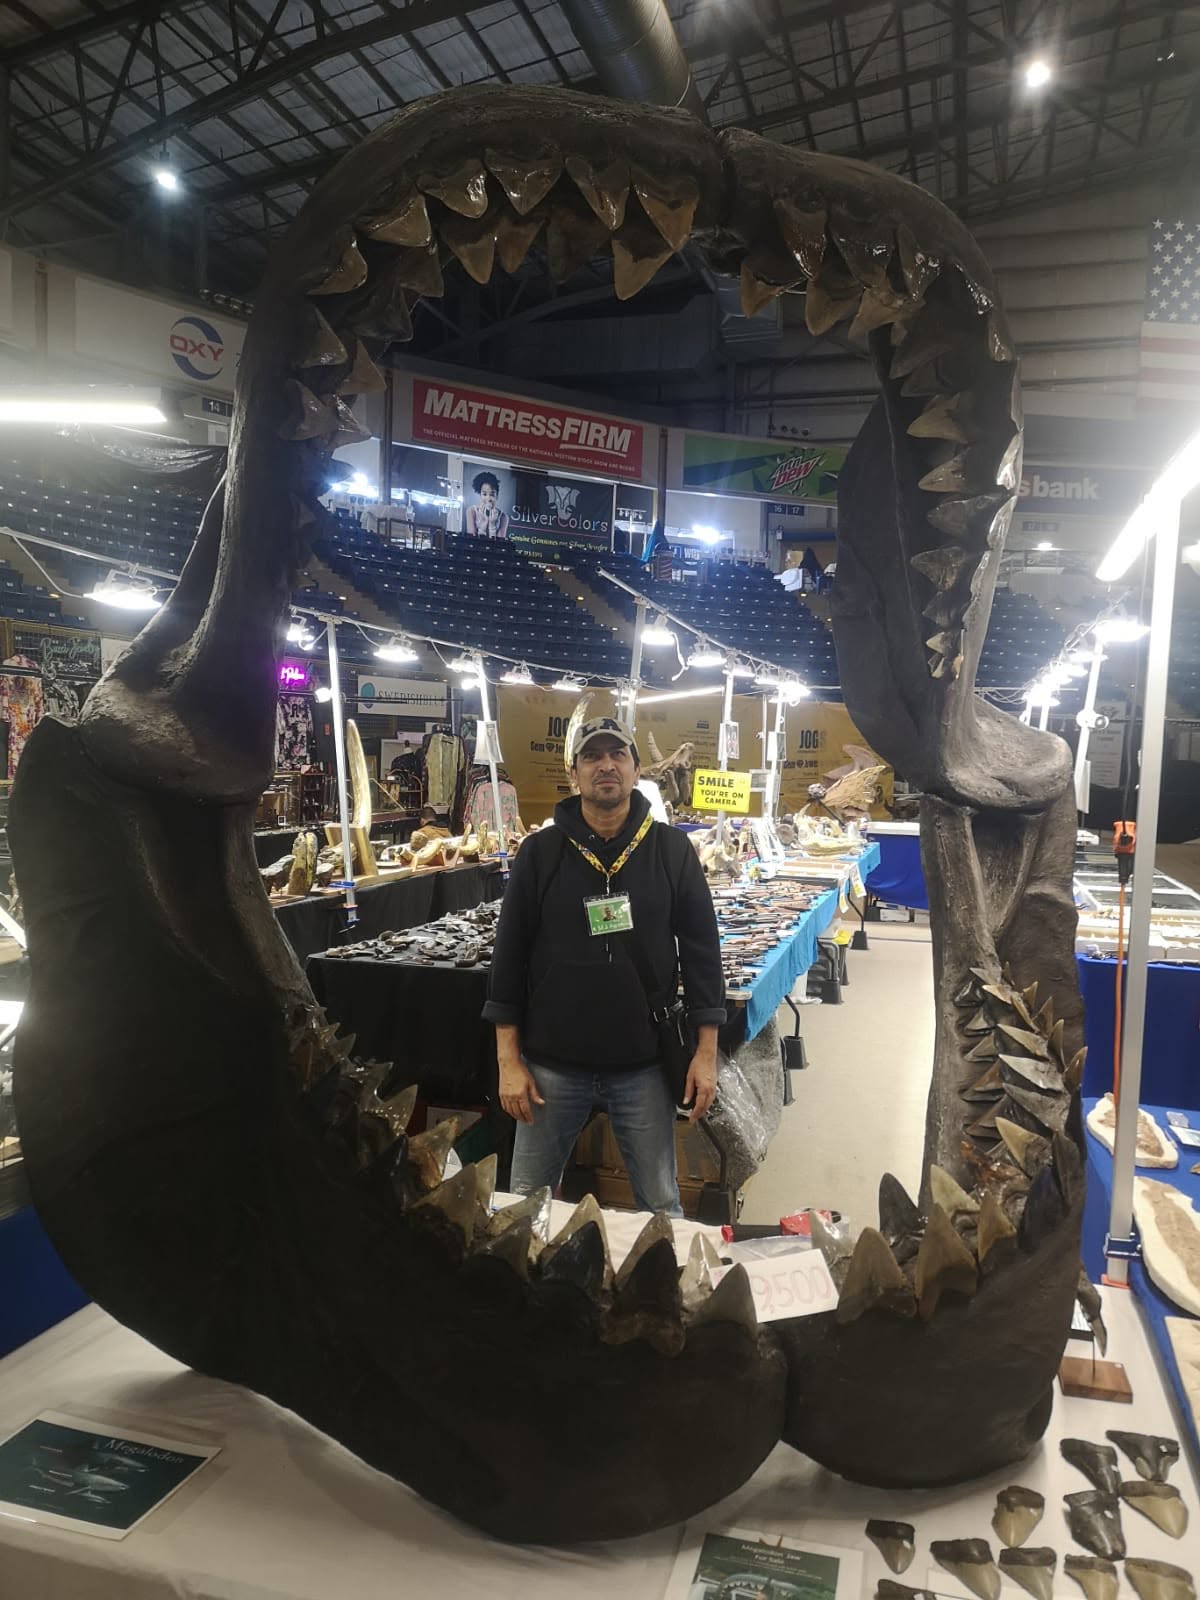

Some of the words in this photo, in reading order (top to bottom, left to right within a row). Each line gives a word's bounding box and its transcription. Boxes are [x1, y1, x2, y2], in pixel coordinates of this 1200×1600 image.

[170, 334, 224, 362] OXY
[208, 401, 220, 412] 14
[1018, 475, 1099, 500] sbank
[698, 776, 734, 788] SMILE
[701, 789, 729, 798] YOU'RE
[732, 791, 744, 799] ON
[705, 797, 737, 806] CAMERA
